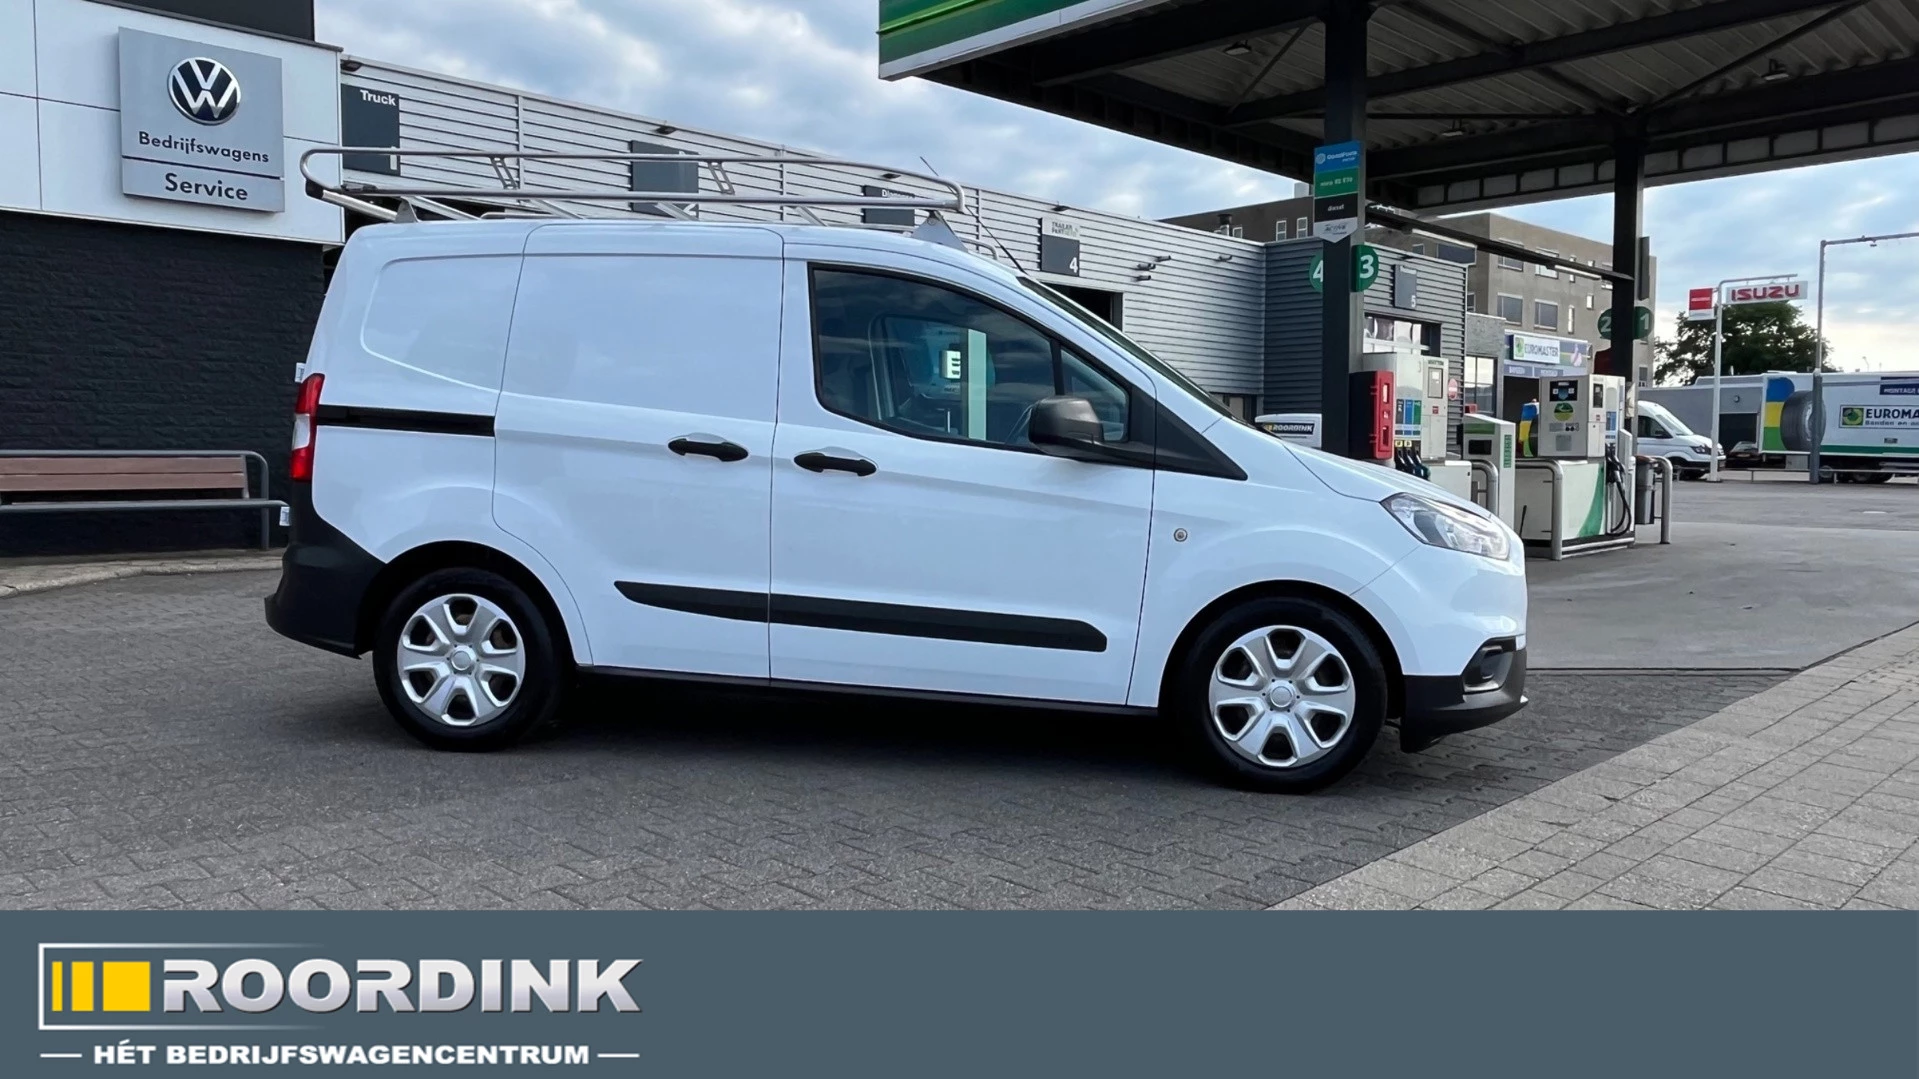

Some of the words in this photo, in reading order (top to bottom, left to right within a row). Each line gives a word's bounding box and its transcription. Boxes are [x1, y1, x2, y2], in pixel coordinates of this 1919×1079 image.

[360, 89, 396, 106] Truck
[139, 131, 269, 162] Bedrijfswagens
[165, 173, 248, 200] Service
[1069, 257, 1079, 273] 4
[1359, 254, 1375, 279] 3
[1411, 295, 1416, 308] 5
[1731, 284, 1799, 302] ISUZU
[1640, 313, 1650, 330] 1
[1524, 343, 1559, 357] EUROMASTER
[1273, 424, 1313, 432] ROORDINK
